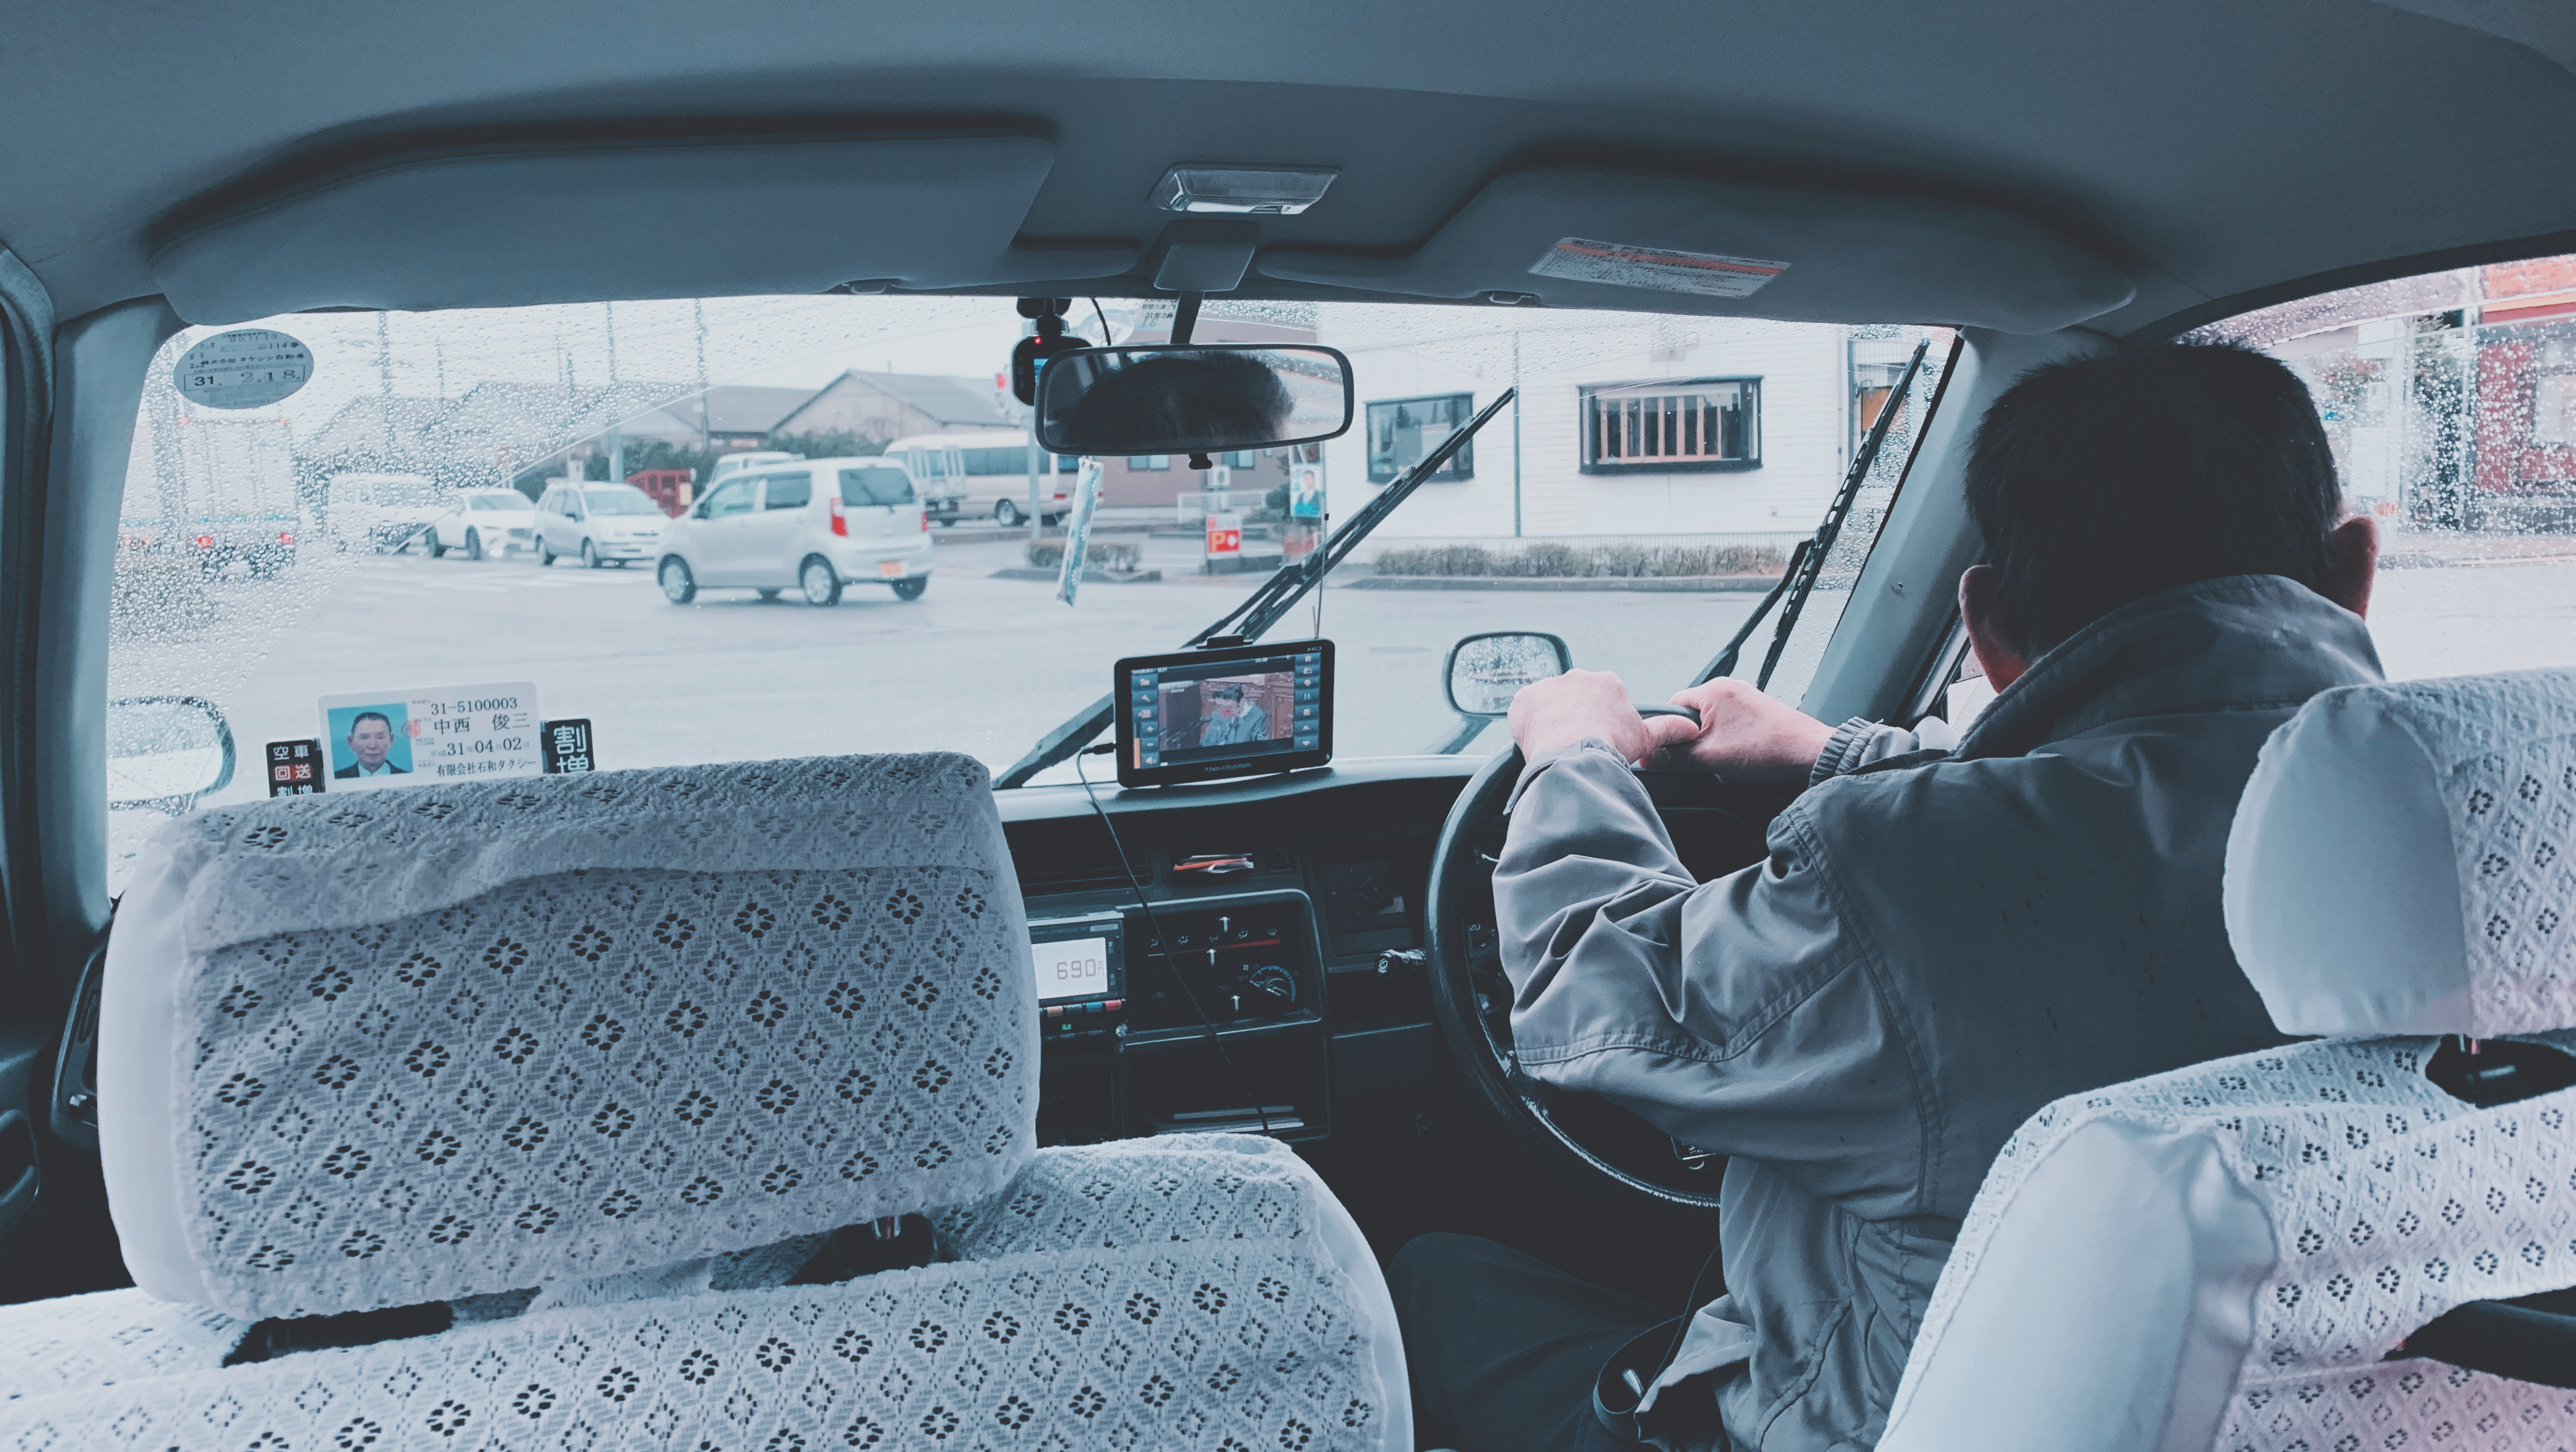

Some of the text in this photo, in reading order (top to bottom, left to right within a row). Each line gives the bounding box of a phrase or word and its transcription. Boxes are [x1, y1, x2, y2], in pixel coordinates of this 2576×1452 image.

[431, 697, 518, 715] 31-5100003
[434, 717, 470, 735] 中西
[491, 713, 530, 731] 俊三
[273, 745, 309, 761] 空車
[275, 763, 312, 781] 回送
[436, 759, 536, 777] 有限会社石和タクシー
